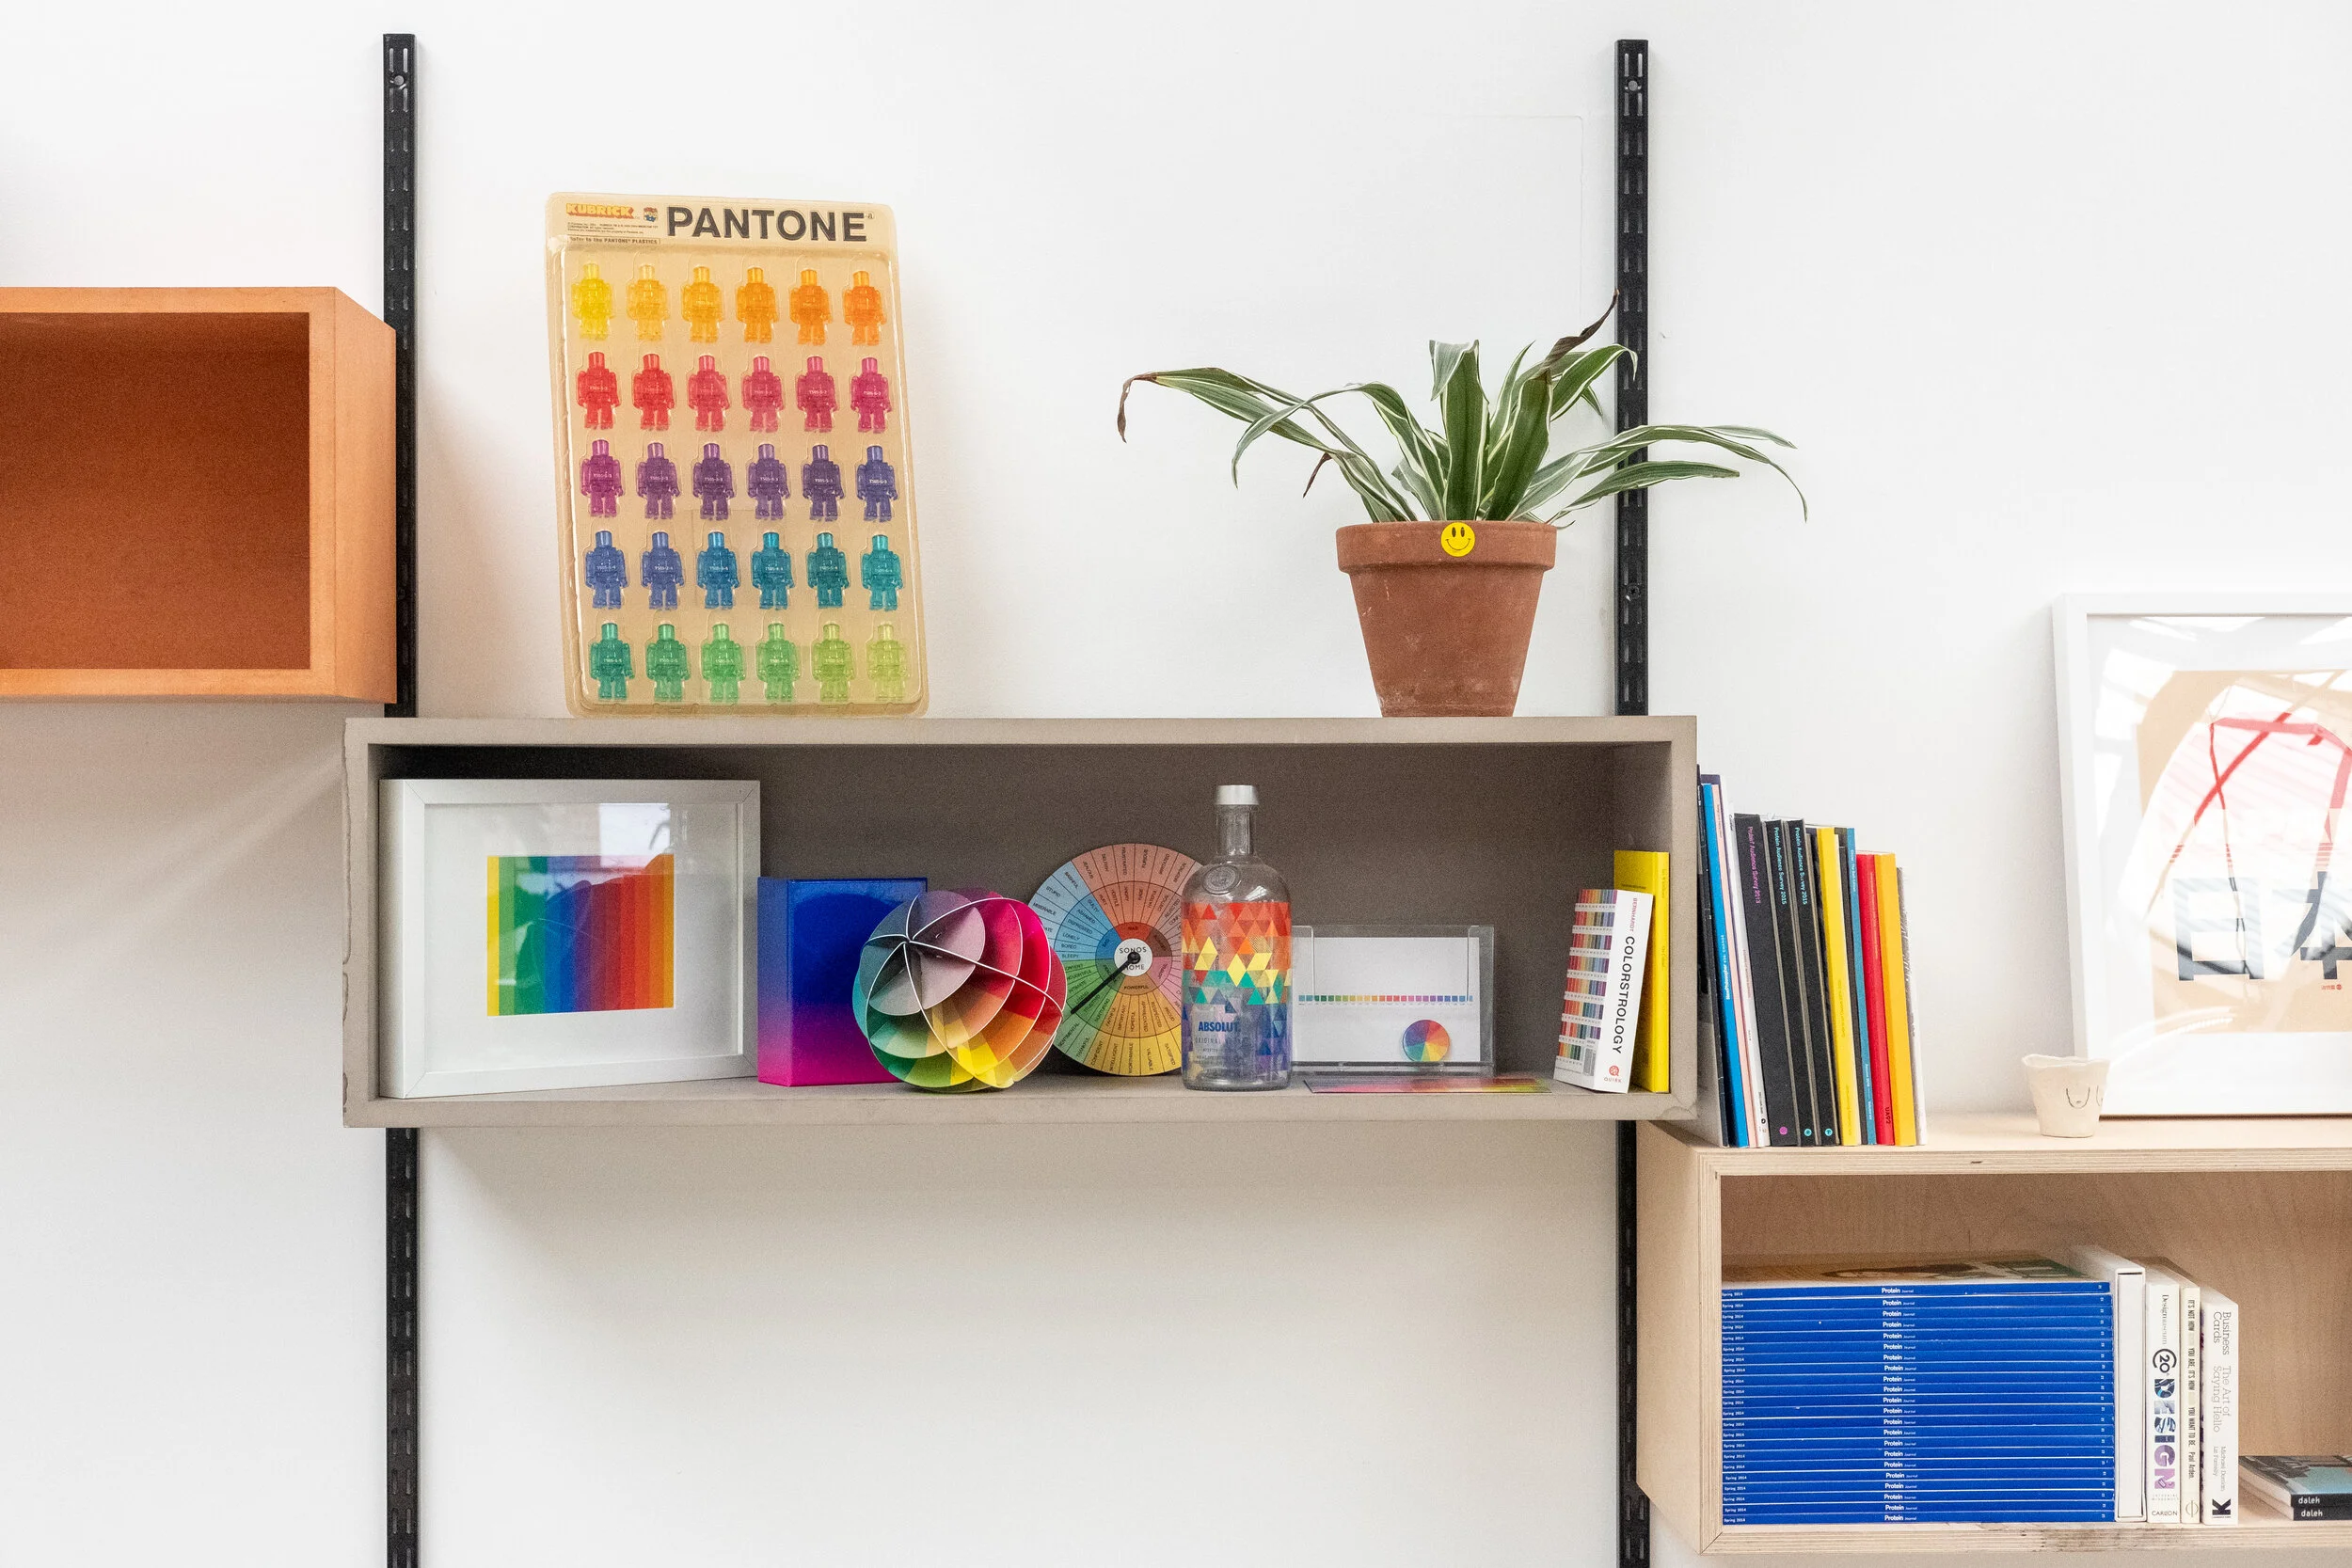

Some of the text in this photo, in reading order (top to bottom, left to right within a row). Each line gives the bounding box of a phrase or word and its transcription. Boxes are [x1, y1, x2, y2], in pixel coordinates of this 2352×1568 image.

[566, 203, 634, 219] KUBRICK
[666, 206, 867, 242] PANTONE
[1159, 853, 1169, 874] IRRITATED
[1064, 871, 1078, 887] BASHFUL
[1046, 885, 1060, 897] STUPID
[1033, 900, 1056, 916] MISERABLE
[1077, 907, 1095, 924] ASHAMED
[1087, 899, 1098, 912] GUILTY
[1164, 899, 1180, 917] REJECTED
[1629, 898, 1638, 932] BERNHARDT
[1068, 917, 1092, 934] DEPRESSED
[1063, 932, 1079, 940] LONELY
[1612, 936, 1635, 1054] COLORSTROLOGY
[1106, 1008, 1115, 1026] FAITHFUL
[1140, 1001, 1151, 1031] APPRECIATED
[1150, 1001, 1163, 1026] RESPECTED
[1164, 1007, 1174, 1021] PROUD
[1057, 1022, 1078, 1046] SENTIMENTAL
[1076, 1037, 1089, 1057] THANKFUL
[1090, 1041, 1102, 1064] CONFIDENT
[1108, 1044, 1116, 1070] INTELLIGENT
[1164, 1043, 1175, 1064] SATISFIED
[2223, 1312, 2231, 1355] Business
[2159, 1354, 2170, 1373] 20
[2211, 1312, 2222, 1432] Cards Saying Hello
[2223, 1406, 2231, 1416] of
[2154, 1379, 2176, 1489] DESIGN
